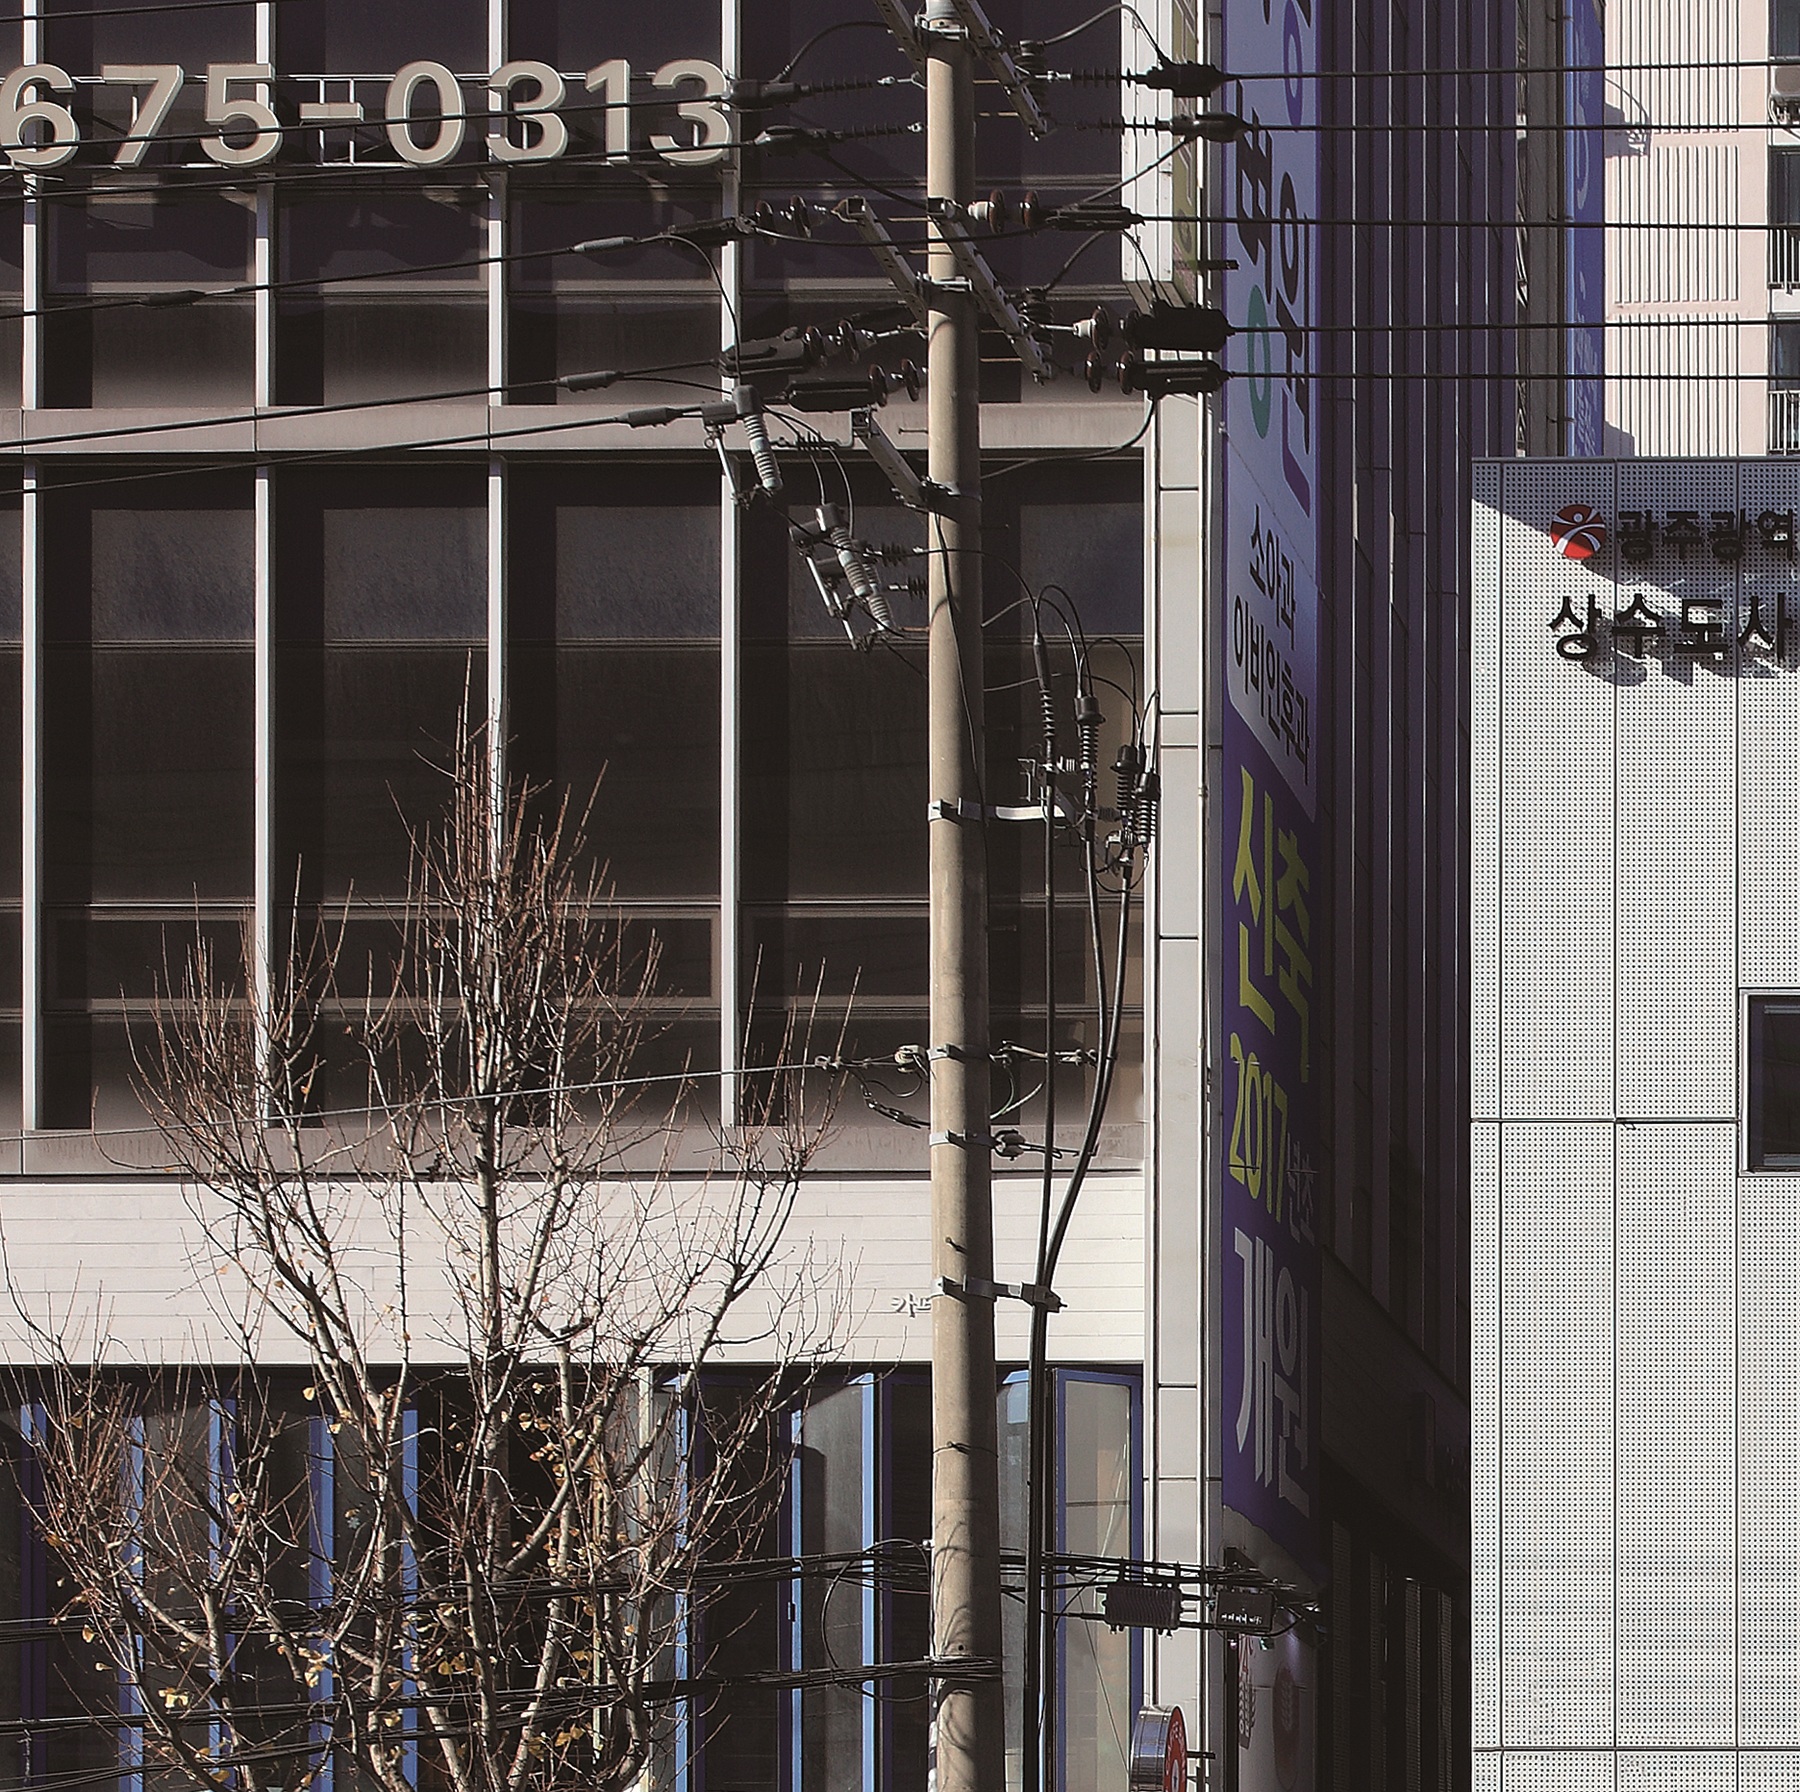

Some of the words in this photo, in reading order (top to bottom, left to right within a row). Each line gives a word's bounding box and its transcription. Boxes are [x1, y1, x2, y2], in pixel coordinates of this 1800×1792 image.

[0, 60, 733, 169] 675-0313
[1250, 504, 1295, 650] 소아과
[1234, 595, 1309, 785] 이비인후과
[1232, 765, 1313, 1084] 신축
[1233, 1226, 1310, 1519] 개원
